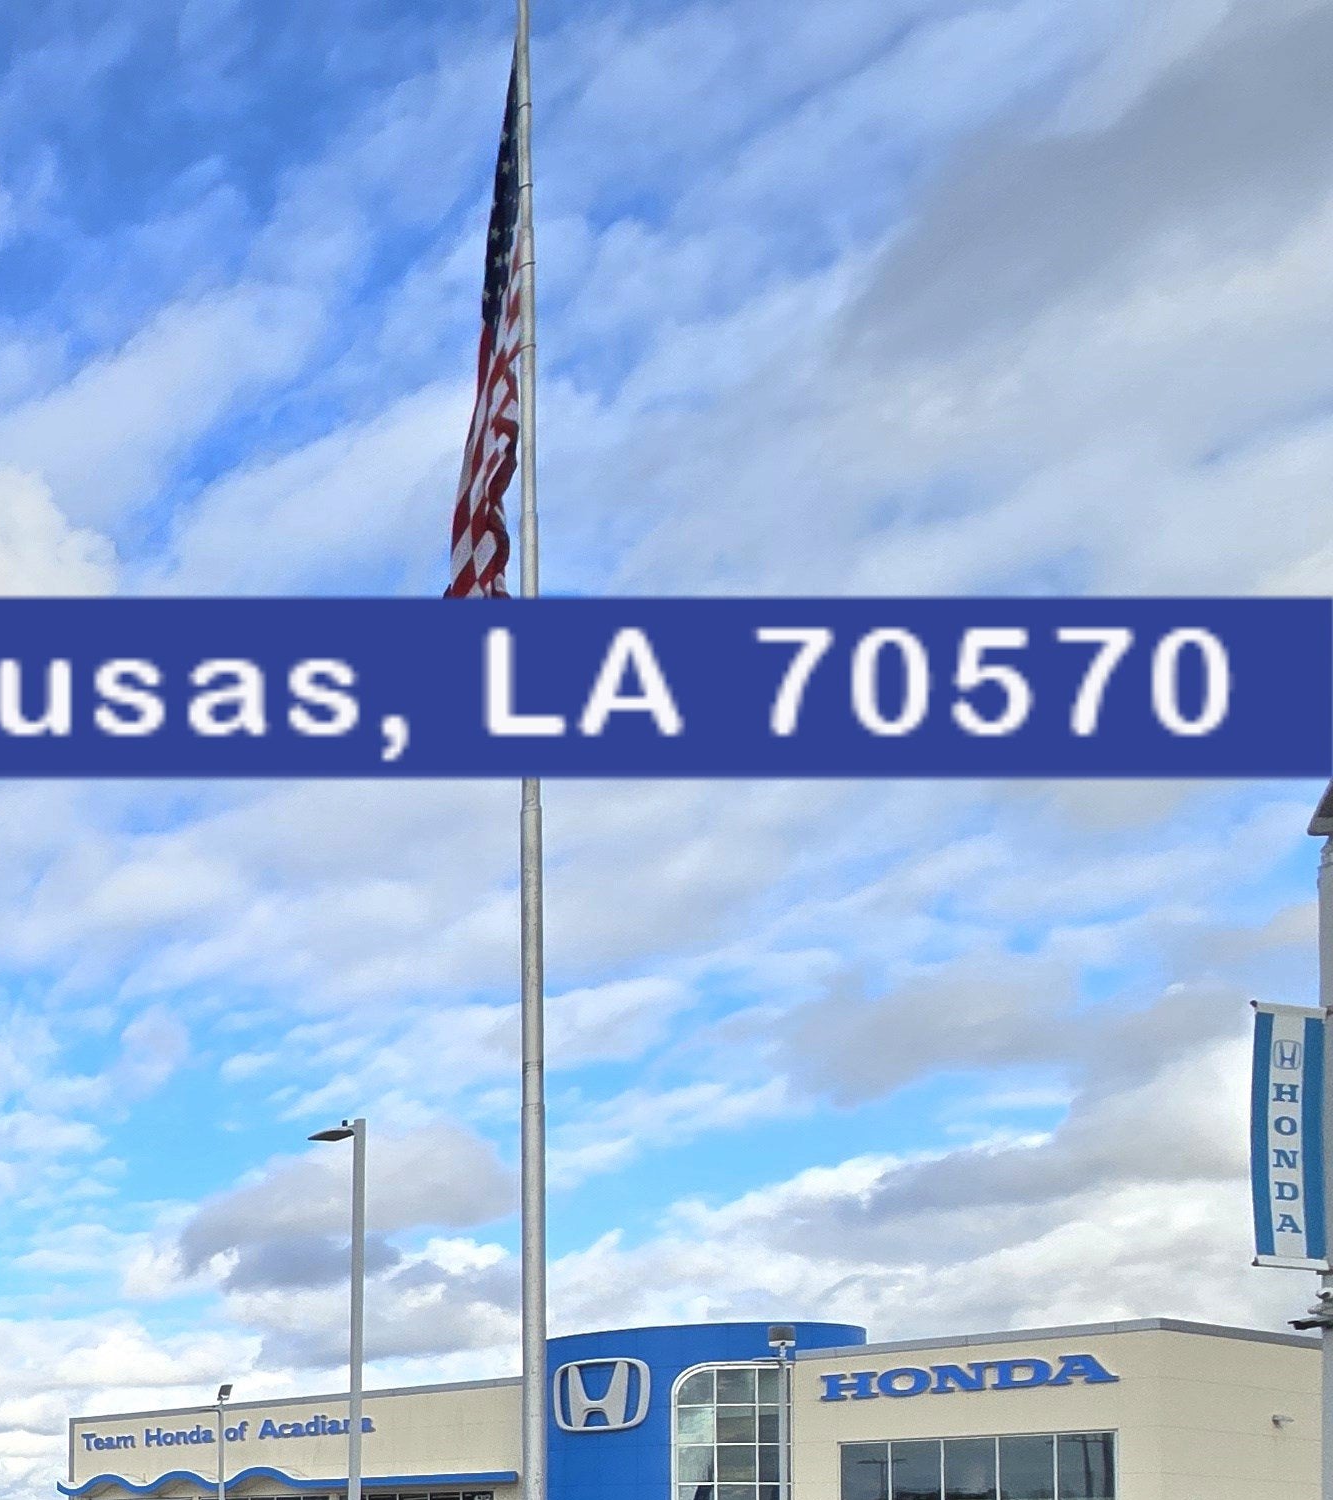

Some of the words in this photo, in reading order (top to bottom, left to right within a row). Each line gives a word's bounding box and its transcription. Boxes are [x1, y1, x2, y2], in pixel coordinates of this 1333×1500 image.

[1272, 1083, 1303, 1233] HONDA
[820, 1354, 1120, 1402] HONDA
[81, 1433, 136, 1451] Team
[144, 1425, 216, 1447] Honda
[224, 1420, 249, 1442] of
